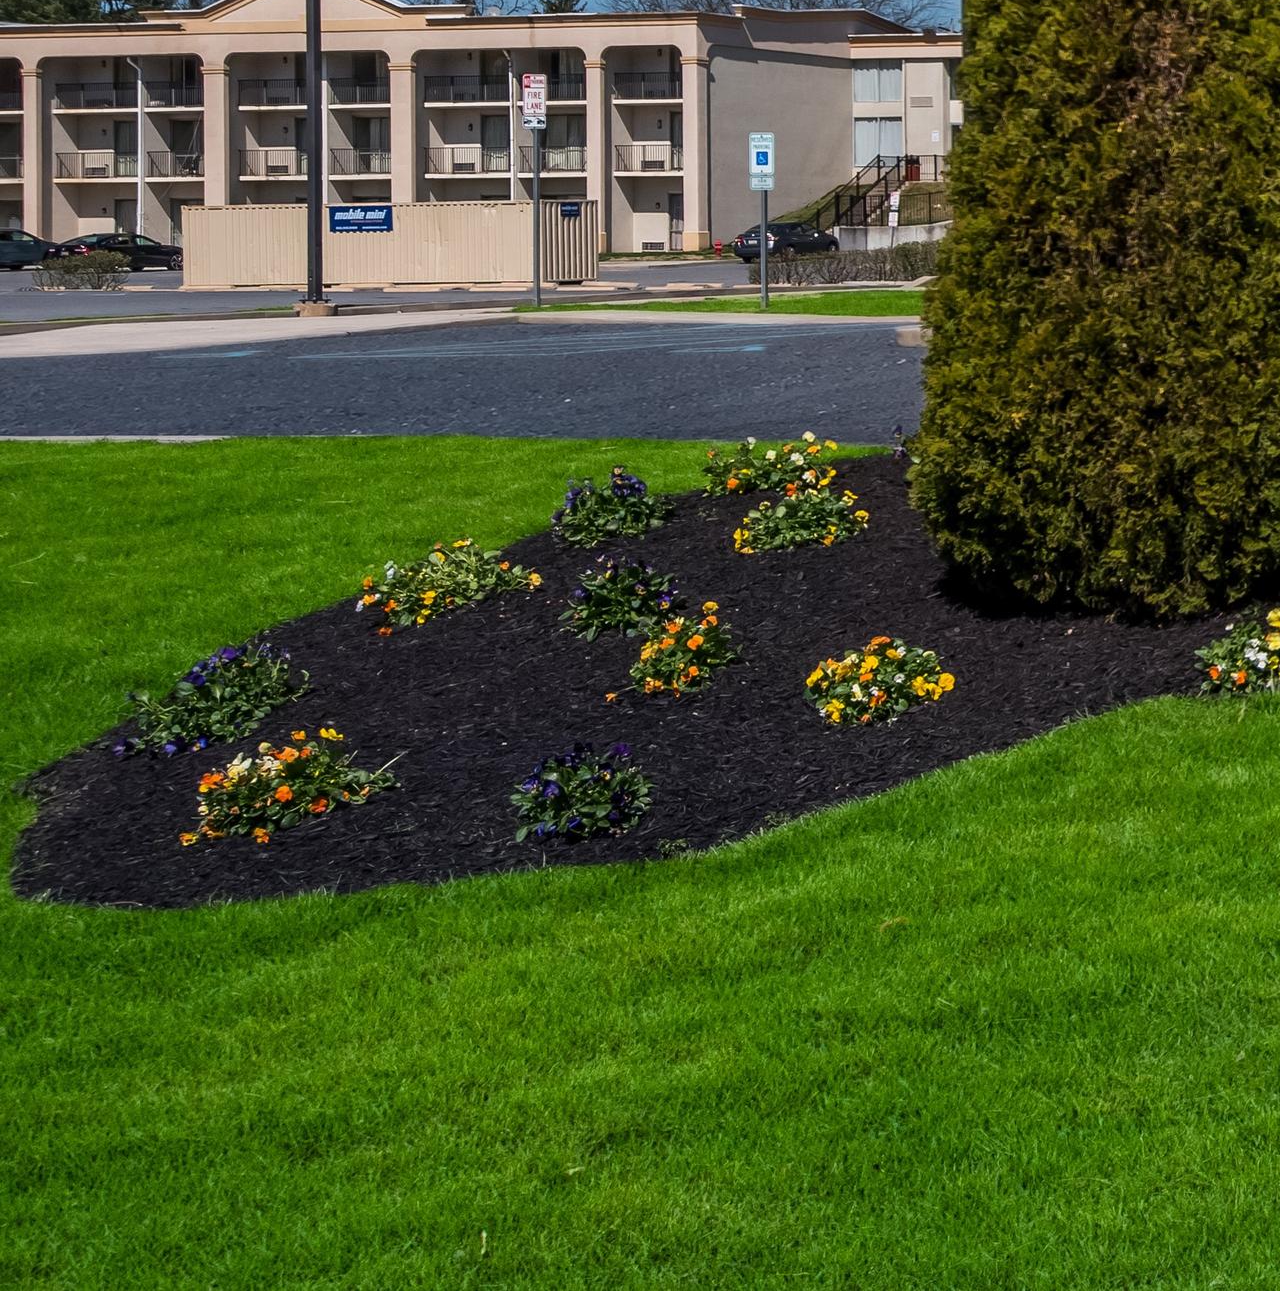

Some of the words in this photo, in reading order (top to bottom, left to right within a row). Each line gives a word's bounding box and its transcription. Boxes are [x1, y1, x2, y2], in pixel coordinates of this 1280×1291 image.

[527, 91, 542, 100] FIRE
[526, 102, 543, 110] LANE
[334, 208, 365, 220] mobile
[365, 209, 387, 219] mini
